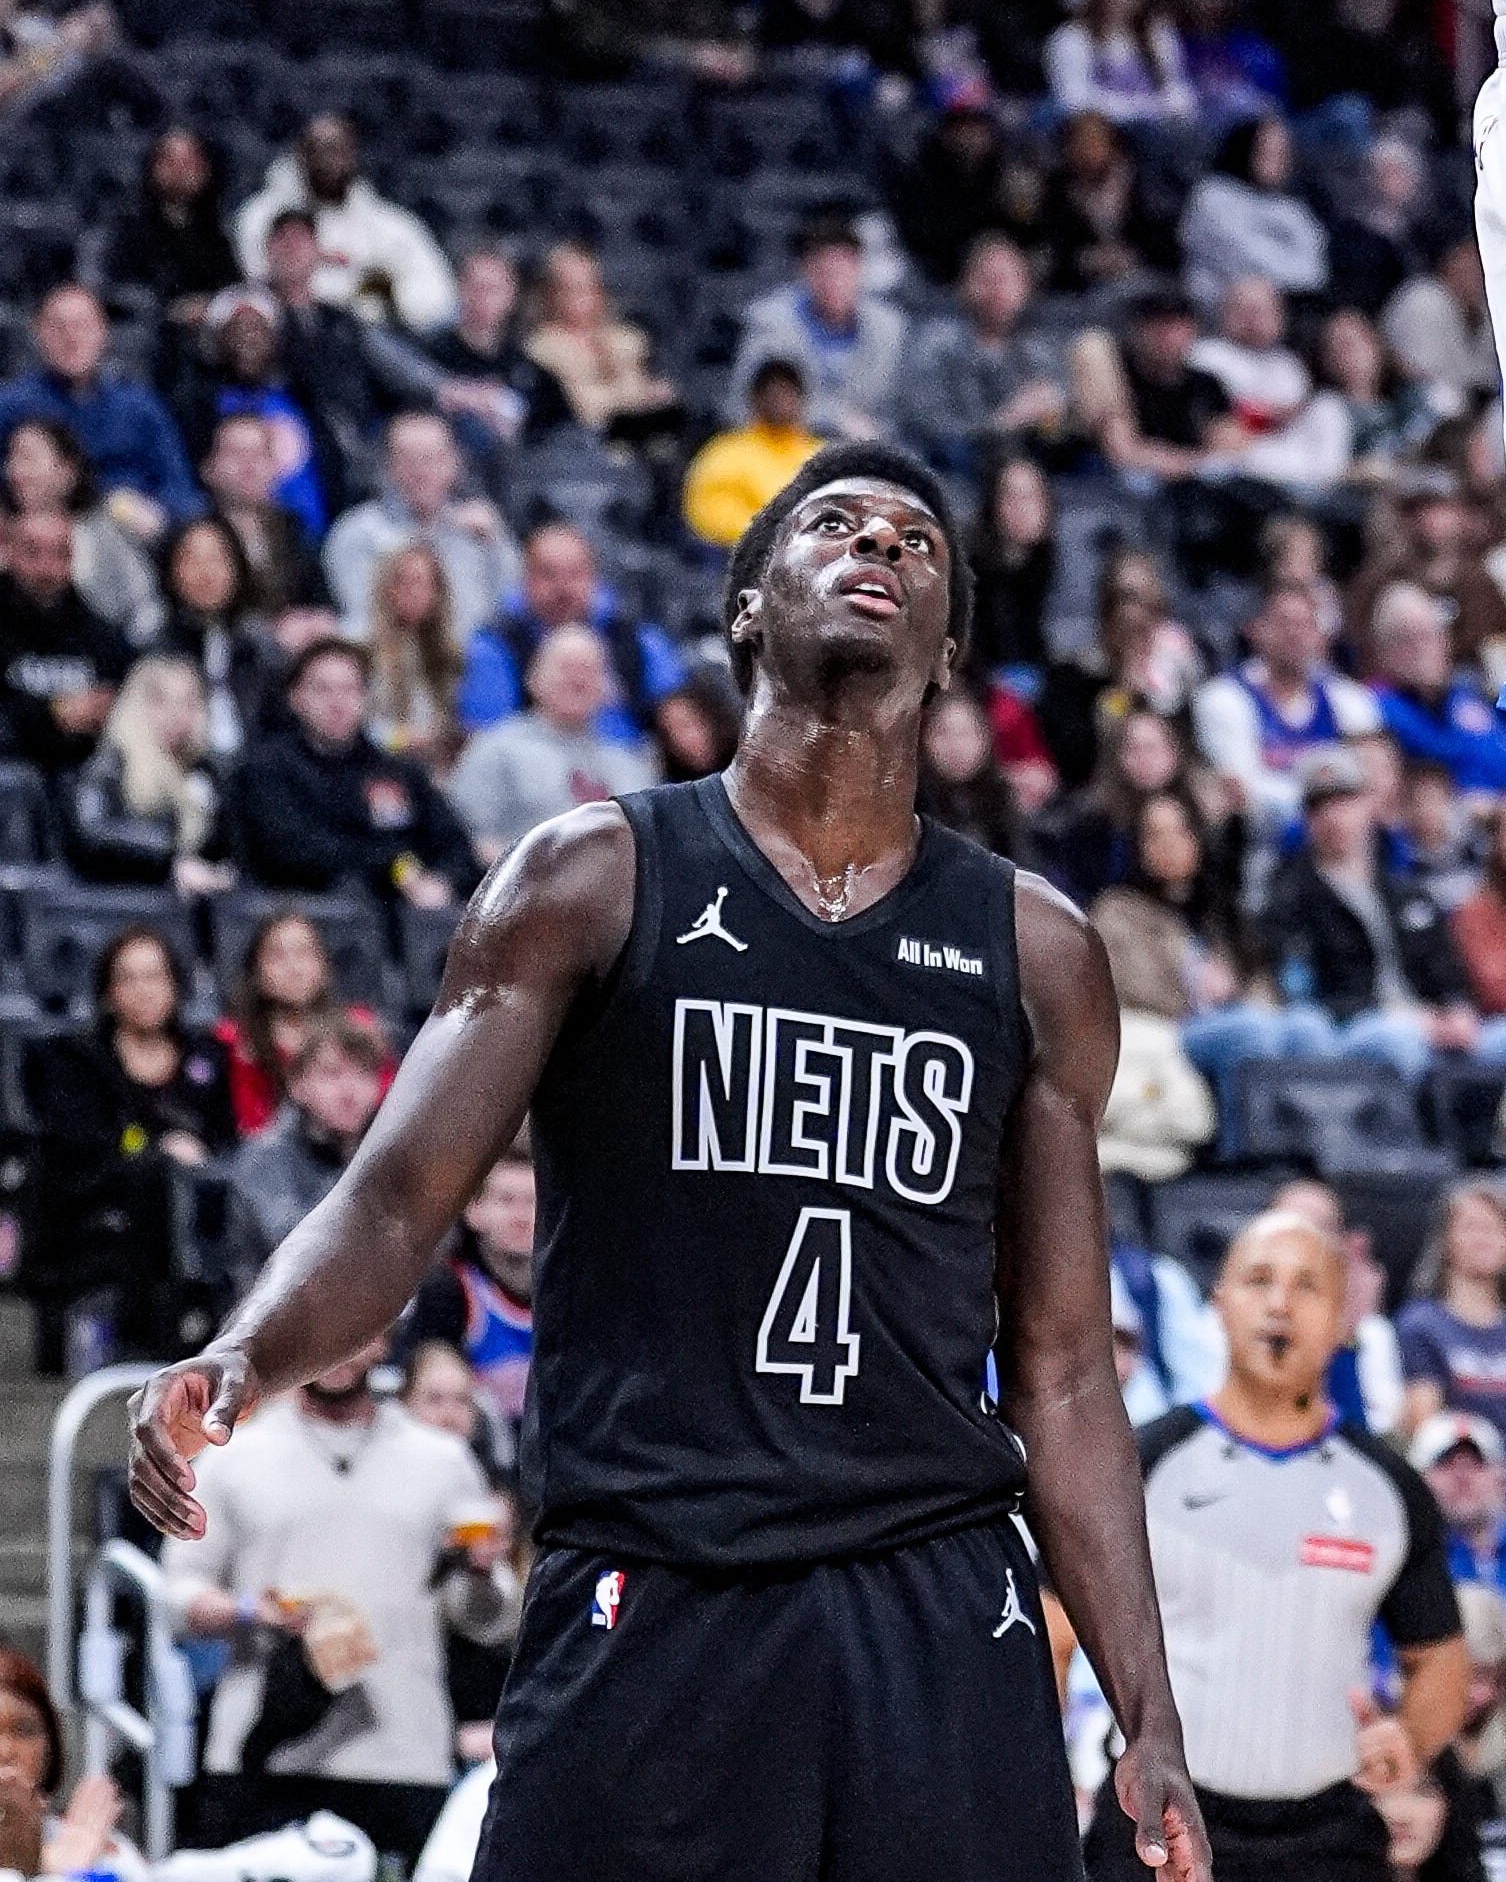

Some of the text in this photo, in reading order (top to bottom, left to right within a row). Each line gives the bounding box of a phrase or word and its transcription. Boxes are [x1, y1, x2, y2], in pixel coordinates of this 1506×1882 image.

[898, 938, 983, 975] All In Won
[672, 998, 974, 1205] NETS
[756, 1207, 860, 1406] 4
